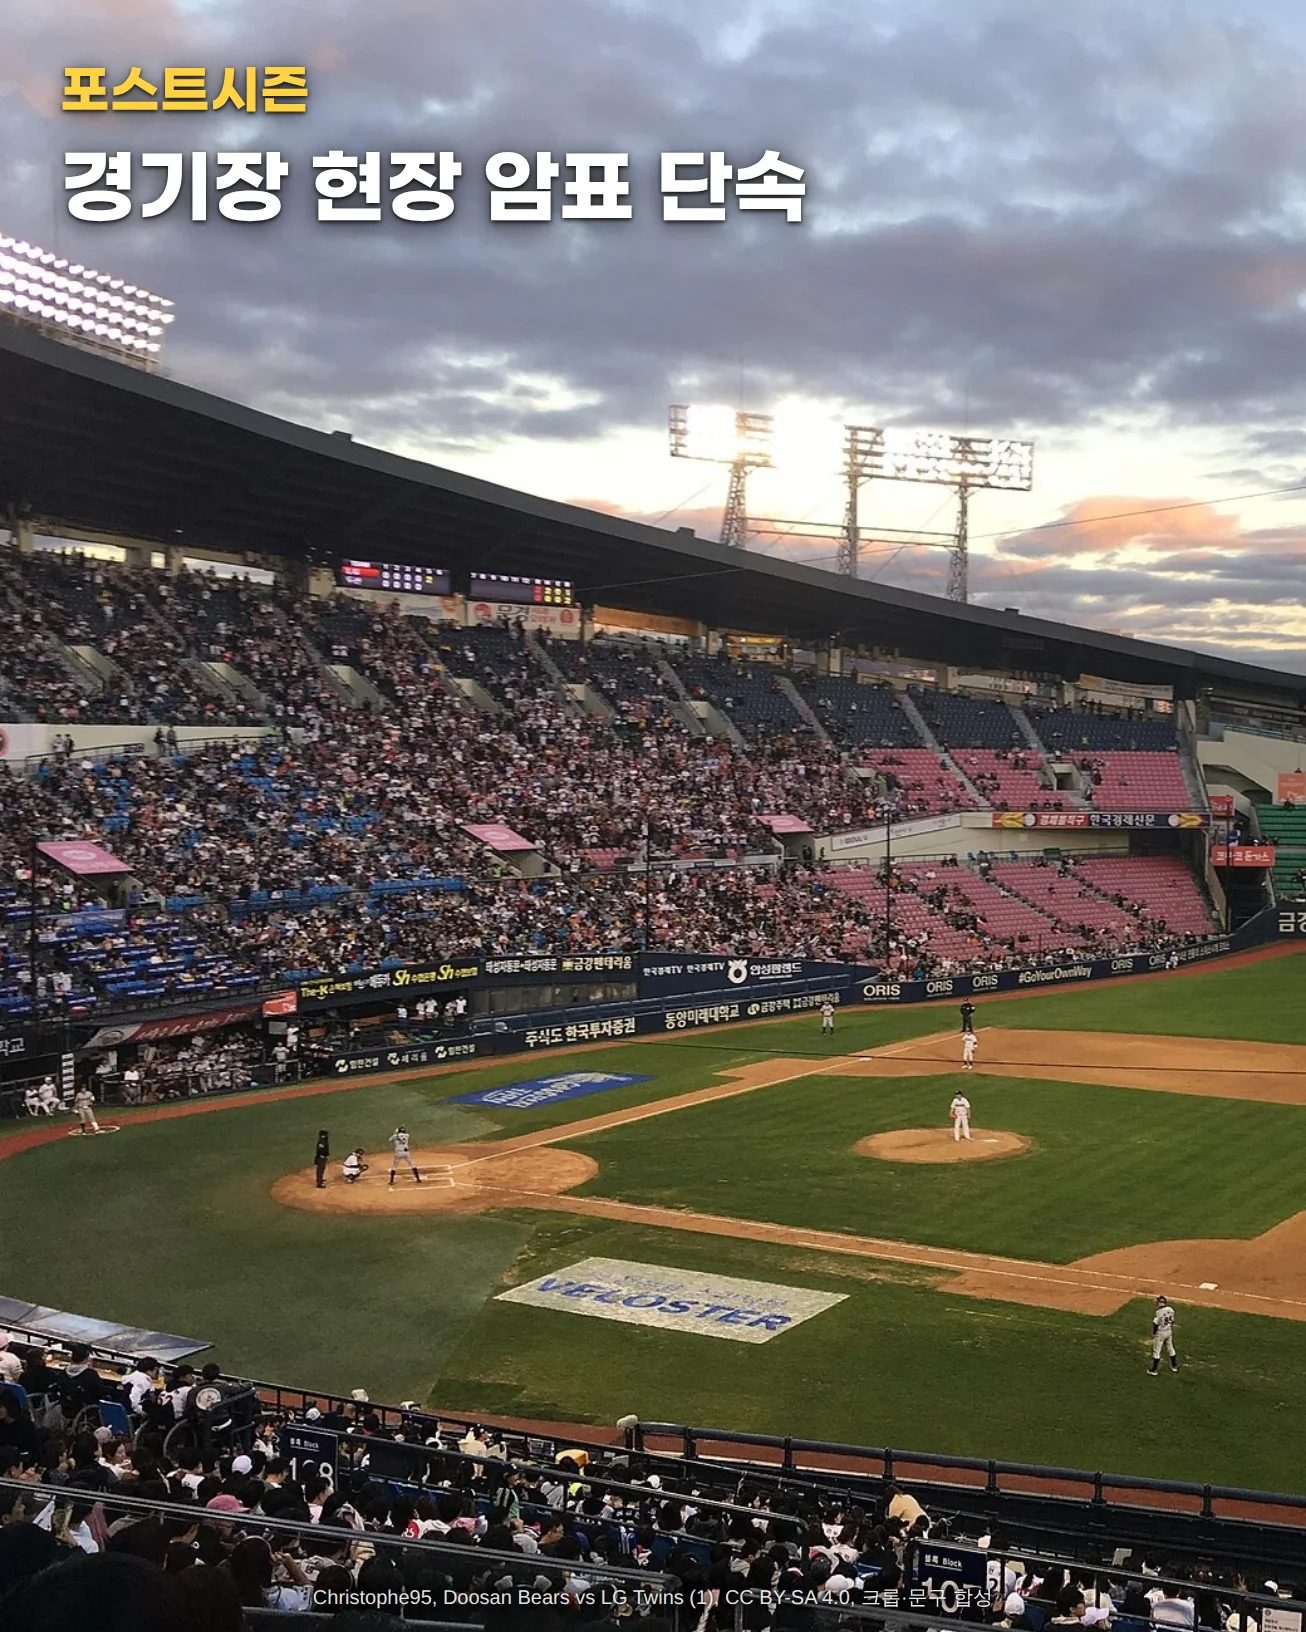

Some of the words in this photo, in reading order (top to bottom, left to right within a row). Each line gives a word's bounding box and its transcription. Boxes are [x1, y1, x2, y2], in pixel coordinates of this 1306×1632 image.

[1090, 814, 1156, 827] 한국경제신문
[750, 962, 802, 976] 안성팜랜드
[1111, 958, 1133, 970] ORIS
[393, 970, 411, 986] Sh
[437, 965, 455, 980] Sh
[1018, 965, 1092, 983] #GoYourOwnWay
[926, 980, 953, 993] ORIS
[972, 975, 998, 988] ORIS
[863, 984, 901, 996] ORIS
[761, 999, 791, 1013] 금강주택
[665, 1004, 740, 1029] 동양미래대학교
[525, 1028, 563, 1047] 주식도
[565, 1017, 636, 1042] 한국투자증권
[536, 1277, 791, 1331] VELOSTER
[303, 1440, 320, 1449] Block
[942, 1557, 962, 1568] Block
